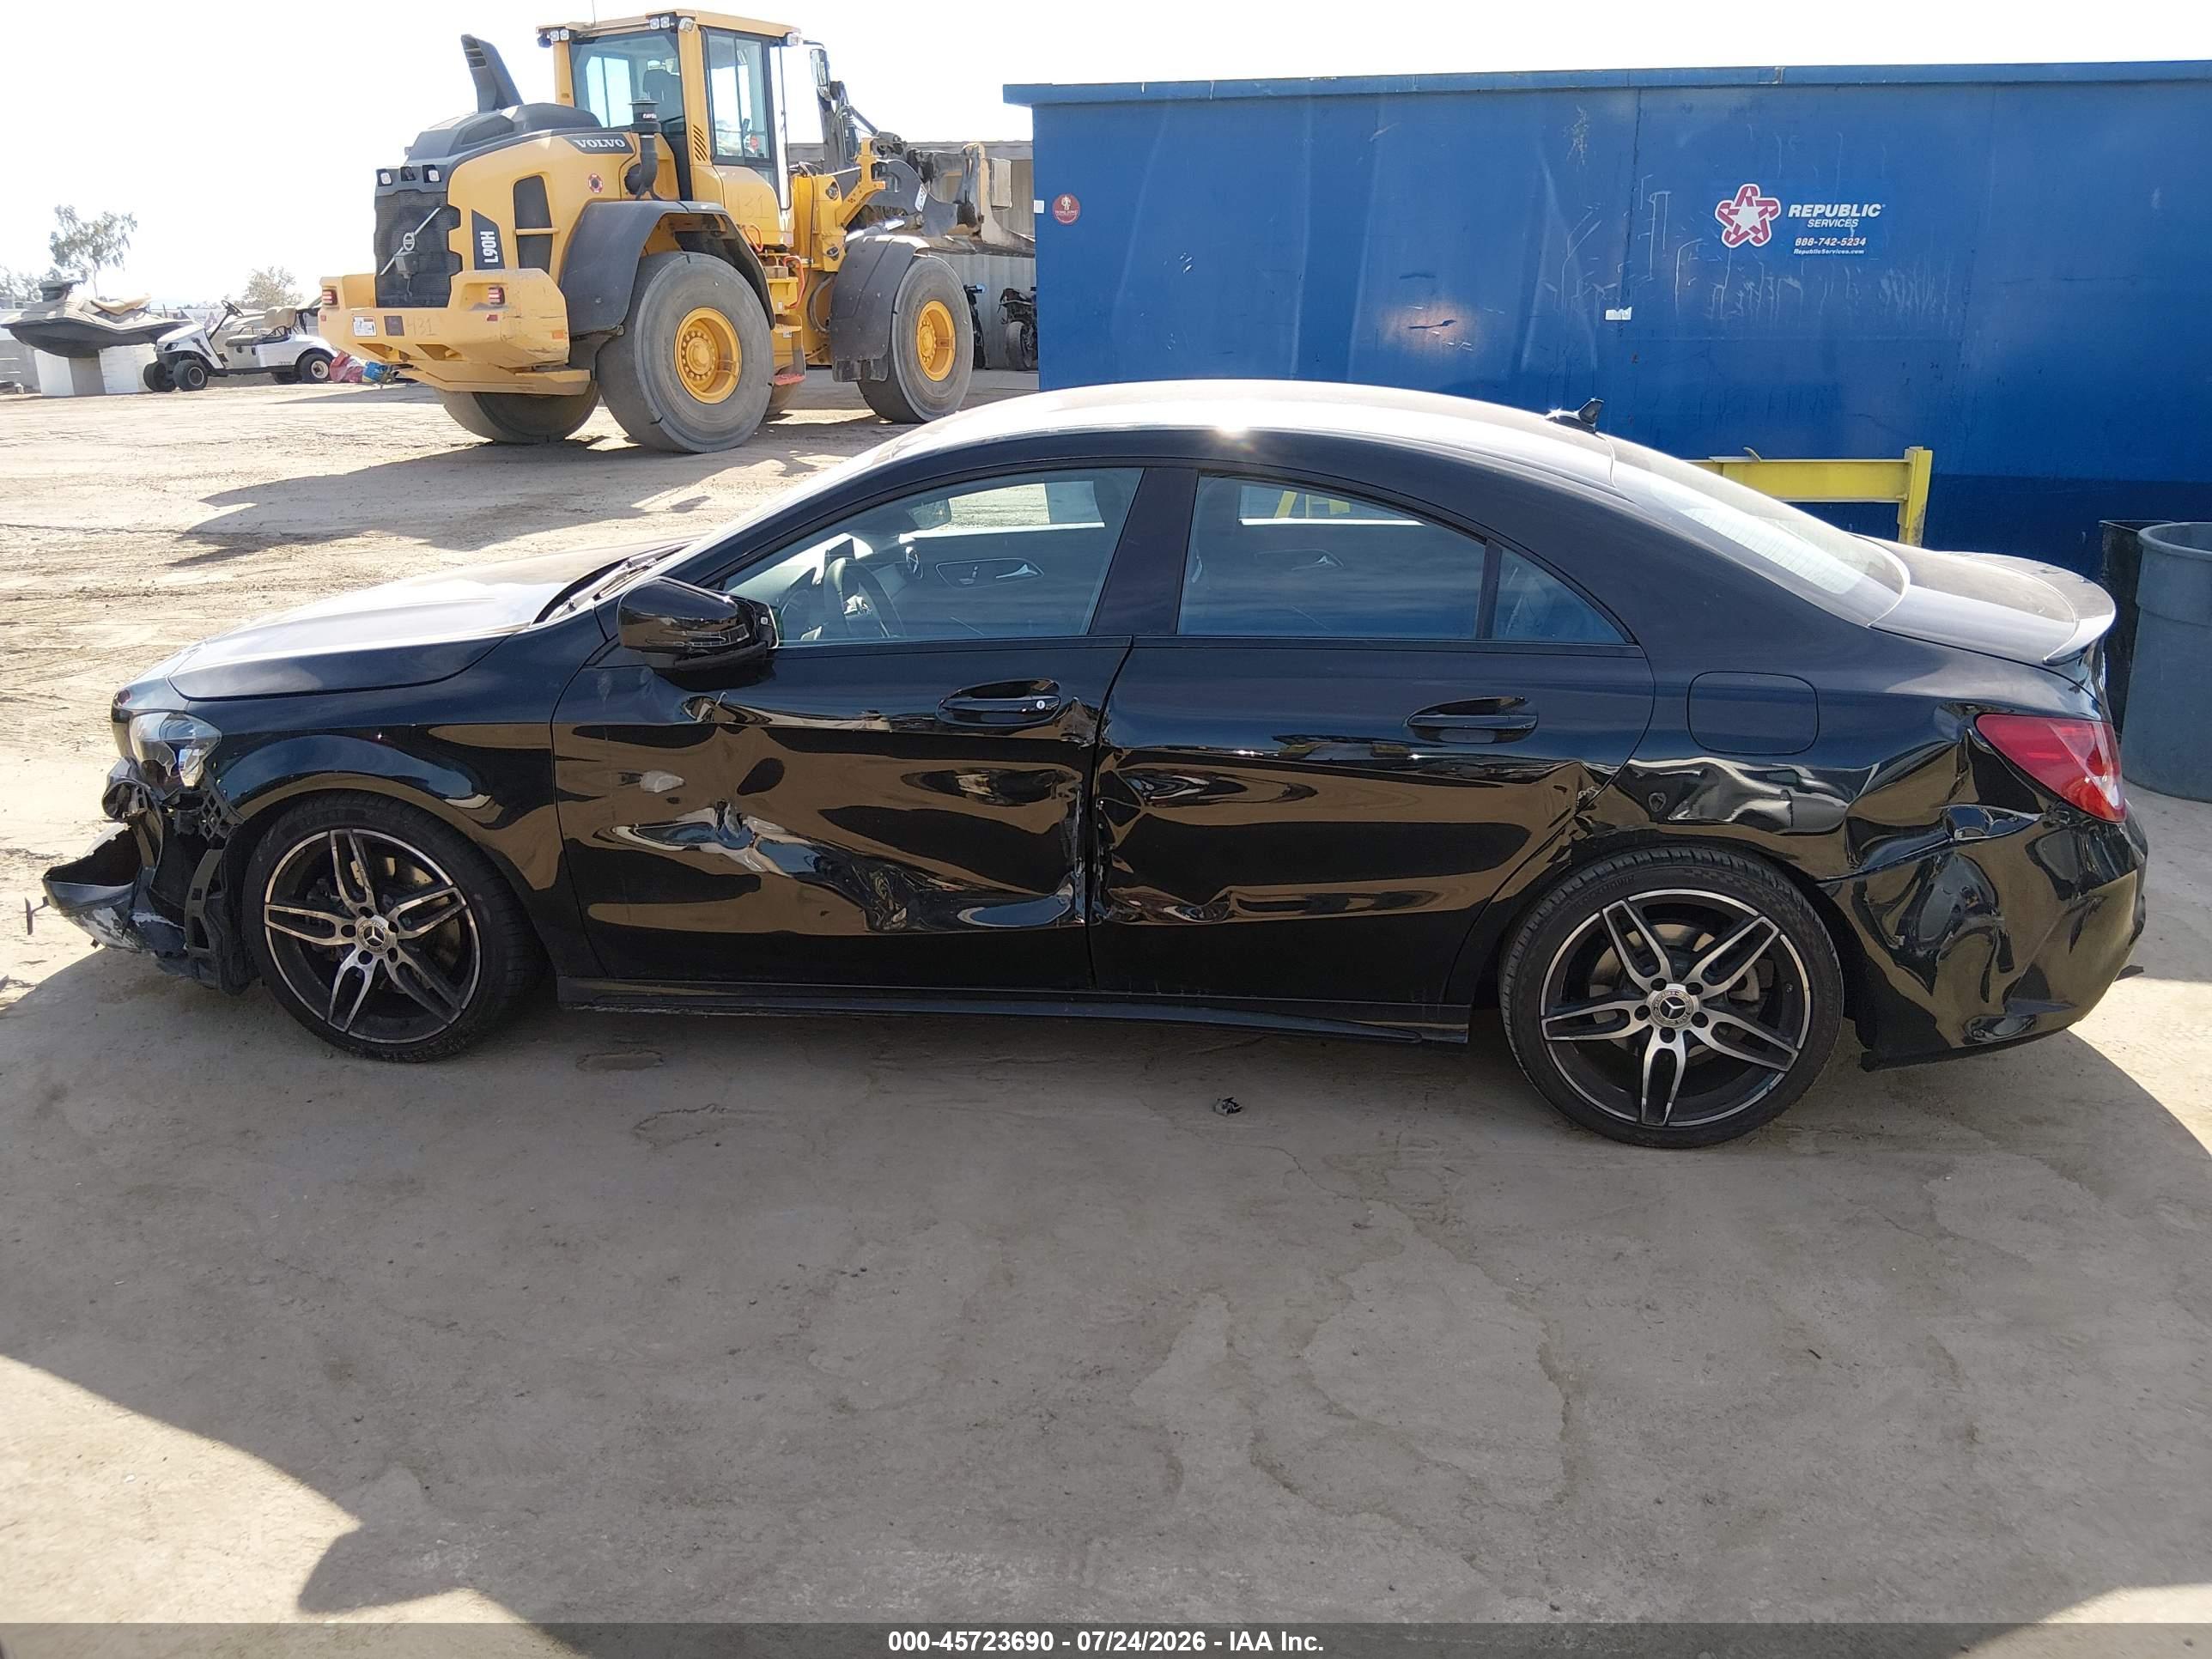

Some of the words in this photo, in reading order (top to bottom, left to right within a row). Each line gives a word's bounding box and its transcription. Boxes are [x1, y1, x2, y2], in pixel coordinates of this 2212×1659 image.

[574, 138, 626, 148] VOLVO
[1788, 204, 1881, 217] REPUBLIC
[1807, 219, 1859, 228] SERVICES
[1795, 237, 1867, 246] 888-742-5234
[480, 231, 499, 263] L90H
